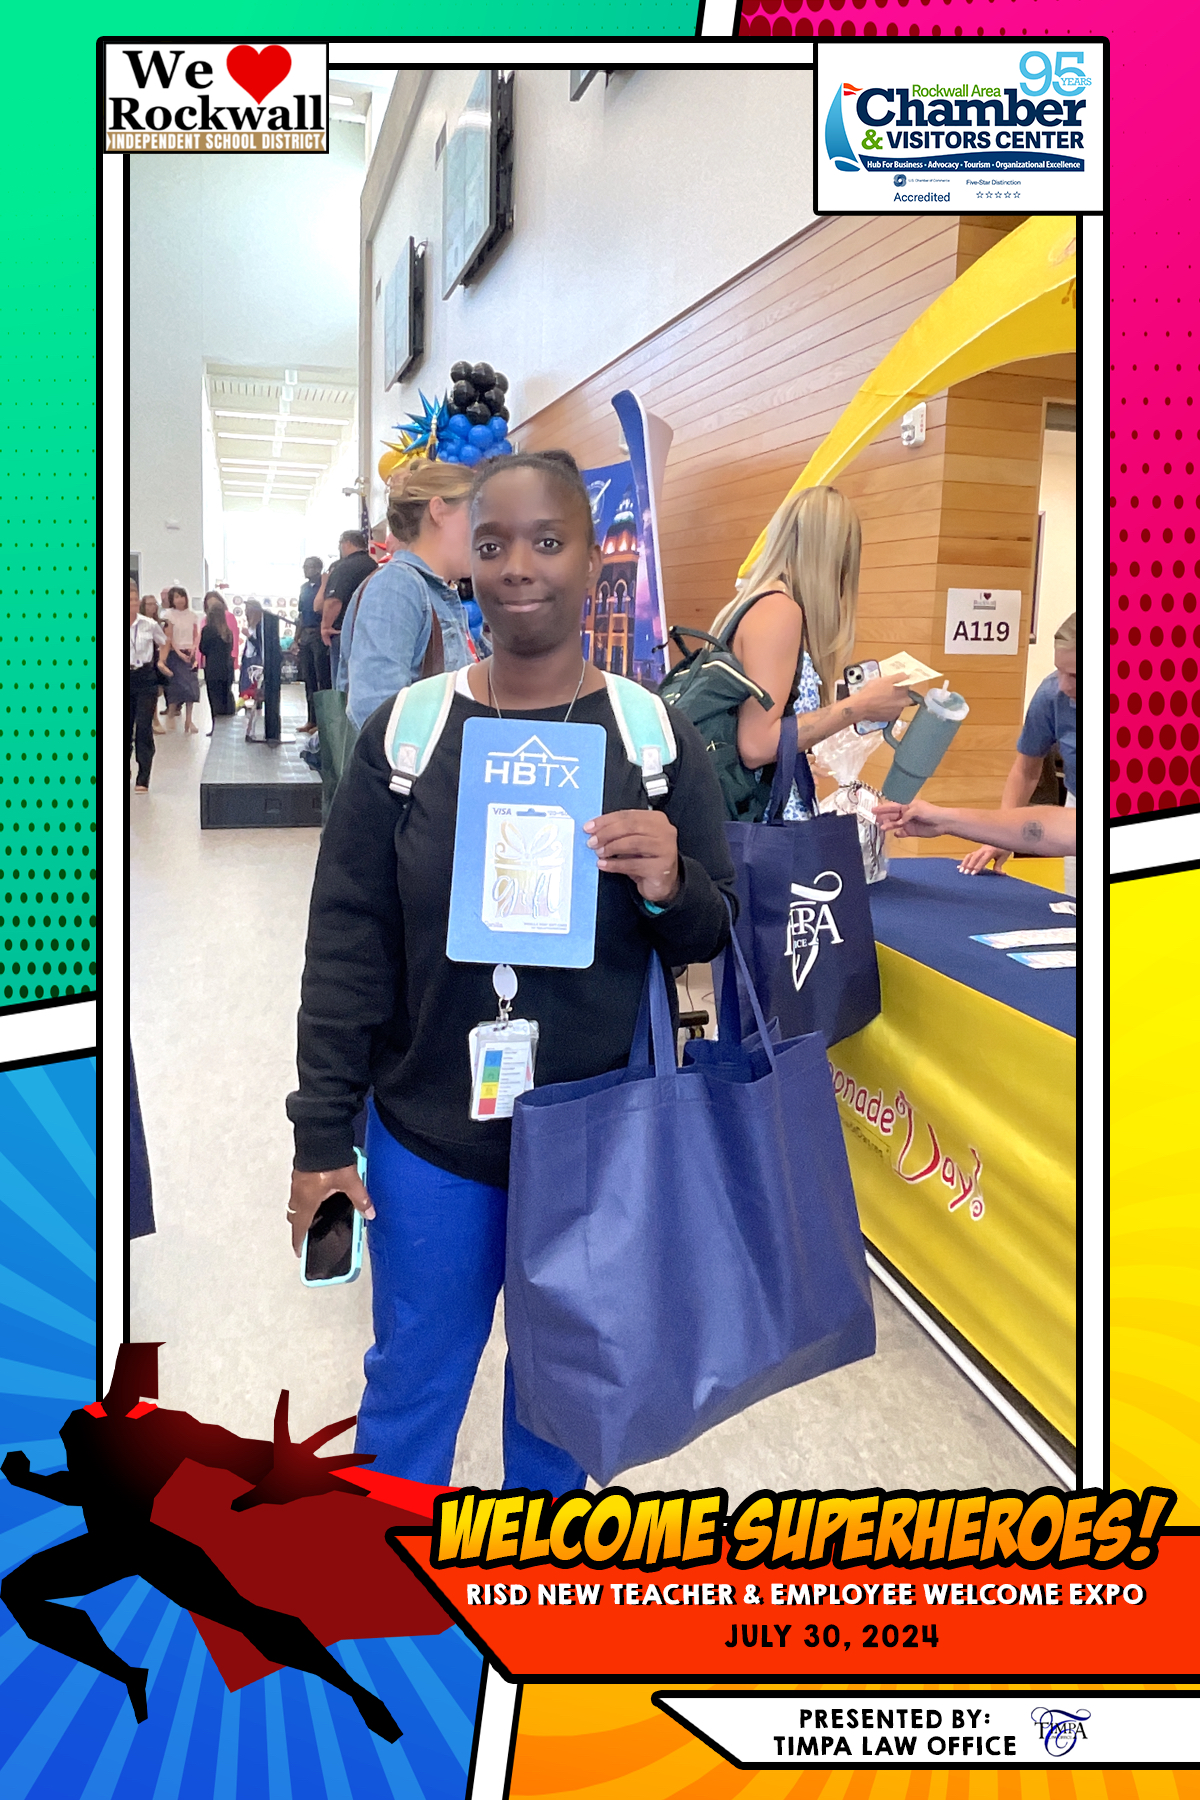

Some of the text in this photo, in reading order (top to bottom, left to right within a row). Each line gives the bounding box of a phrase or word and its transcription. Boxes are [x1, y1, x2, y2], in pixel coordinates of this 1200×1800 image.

[952, 620, 1010, 642] A119
[484, 760, 580, 789] HBTX
[492, 807, 512, 816] VISA
